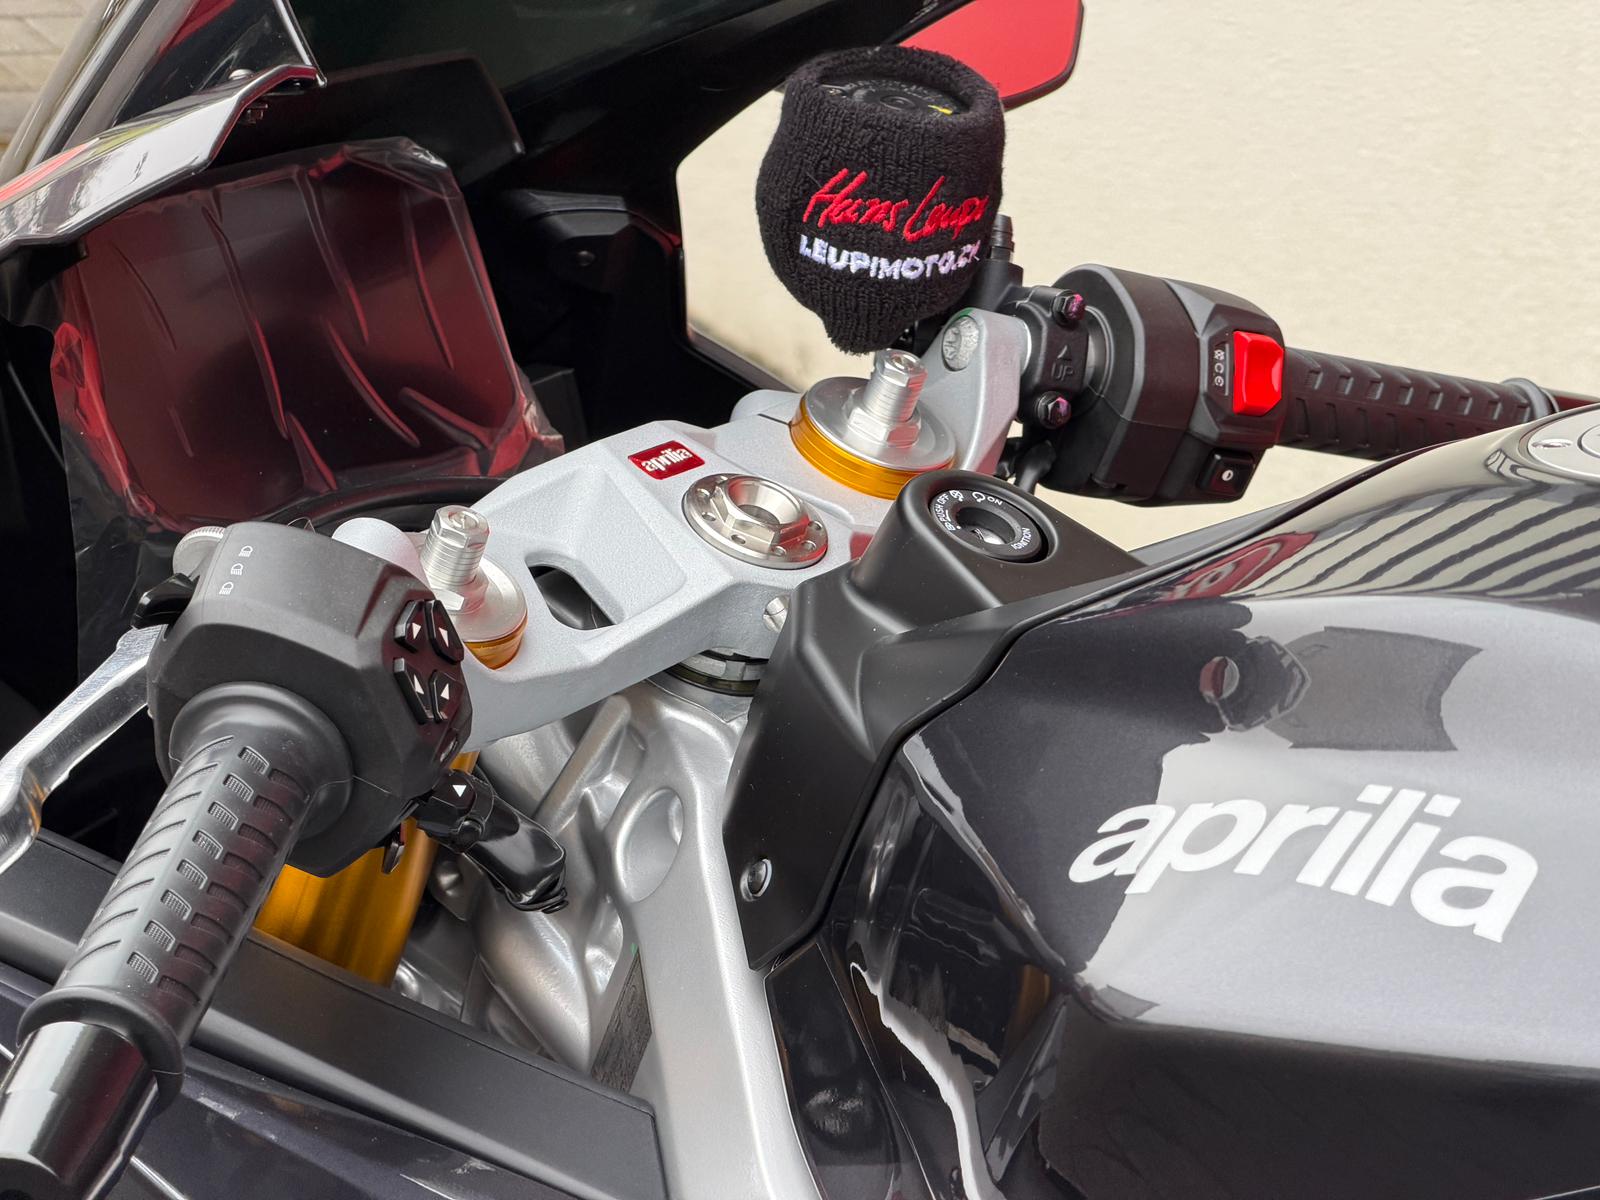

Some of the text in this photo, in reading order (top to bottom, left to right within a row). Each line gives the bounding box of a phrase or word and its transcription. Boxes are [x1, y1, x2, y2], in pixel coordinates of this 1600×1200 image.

[802, 168, 909, 232] Hans
[1051, 361, 1074, 381] UP
[641, 448, 693, 472] aprilia
[935, 494, 949, 521] PUSH OFF
[987, 496, 1003, 505] ON
[1011, 527, 1032, 550] IGNITION
[1068, 784, 1538, 943] aprilia
